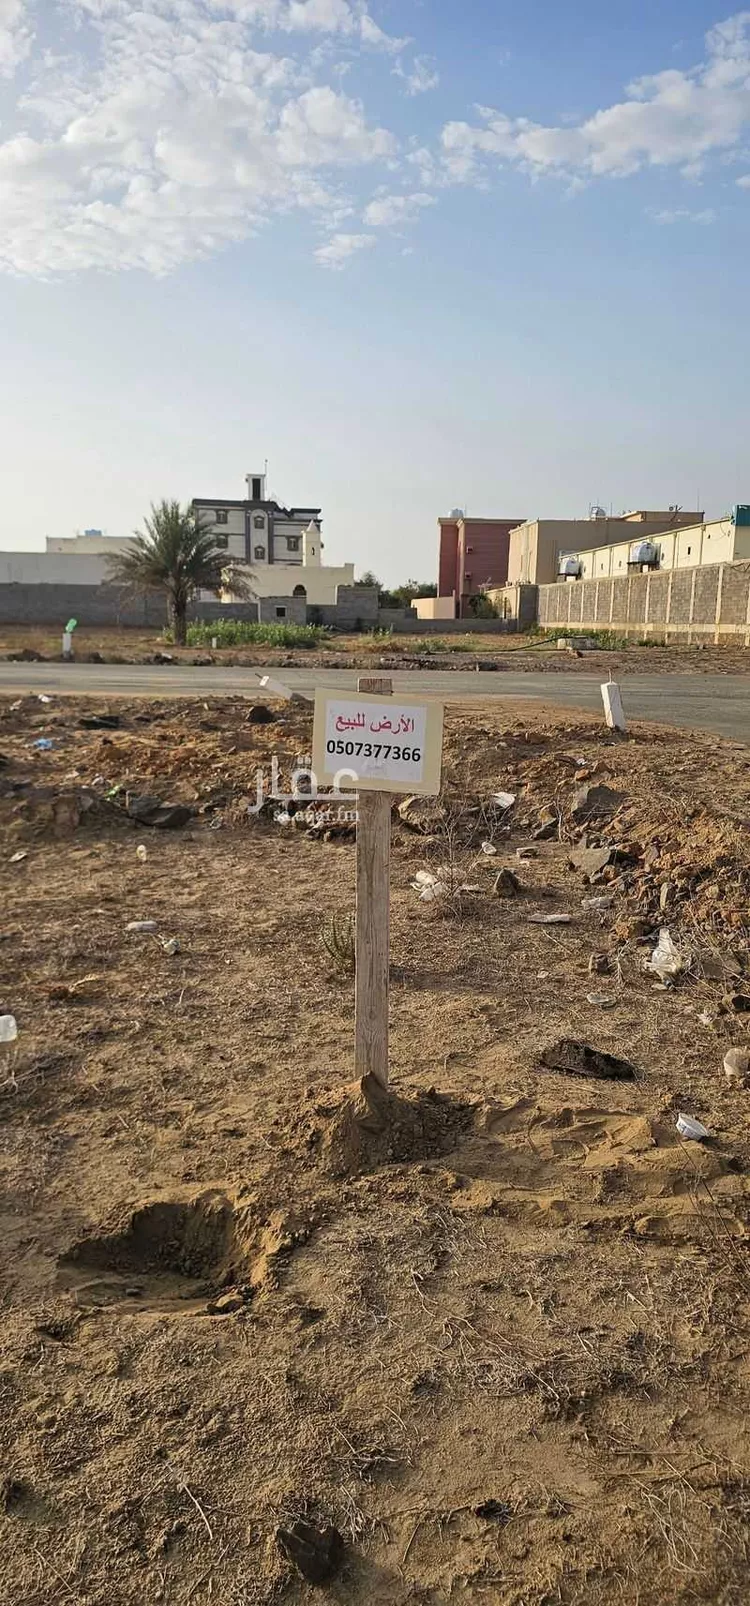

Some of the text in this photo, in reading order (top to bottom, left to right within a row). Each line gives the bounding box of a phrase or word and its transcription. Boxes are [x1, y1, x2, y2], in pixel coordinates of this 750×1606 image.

[335, 712, 415, 734] الأرض للبيع
[326, 740, 421, 762] 0507377366
